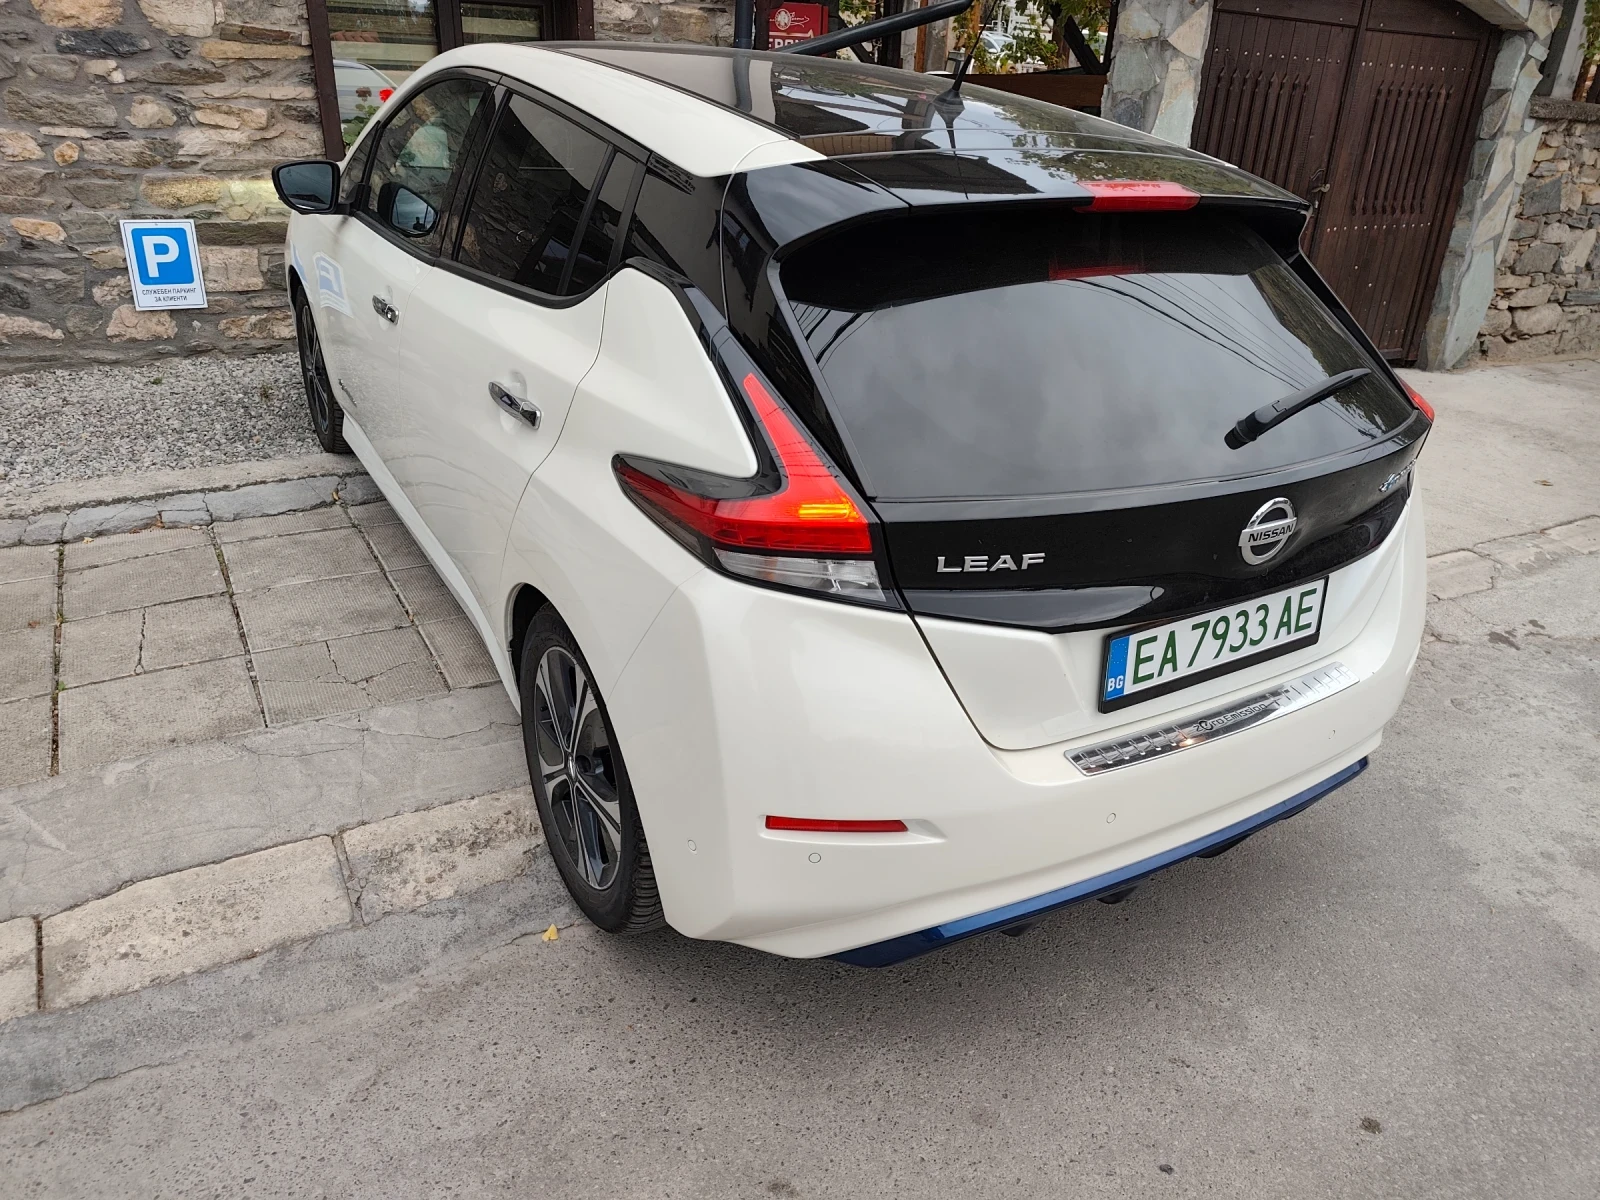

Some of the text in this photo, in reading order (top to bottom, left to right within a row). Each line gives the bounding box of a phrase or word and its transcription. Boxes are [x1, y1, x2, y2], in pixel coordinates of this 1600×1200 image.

[141, 235, 180, 278] P
[141, 288, 172, 296] СЛУЖЕБЕН
[1248, 523, 1294, 543] NISSAN
[936, 552, 1046, 573] LEAF
[1132, 587, 1318, 685] EA 7933 AE
[1107, 675, 1124, 692] BG
[1223, 703, 1267, 722] Emission
